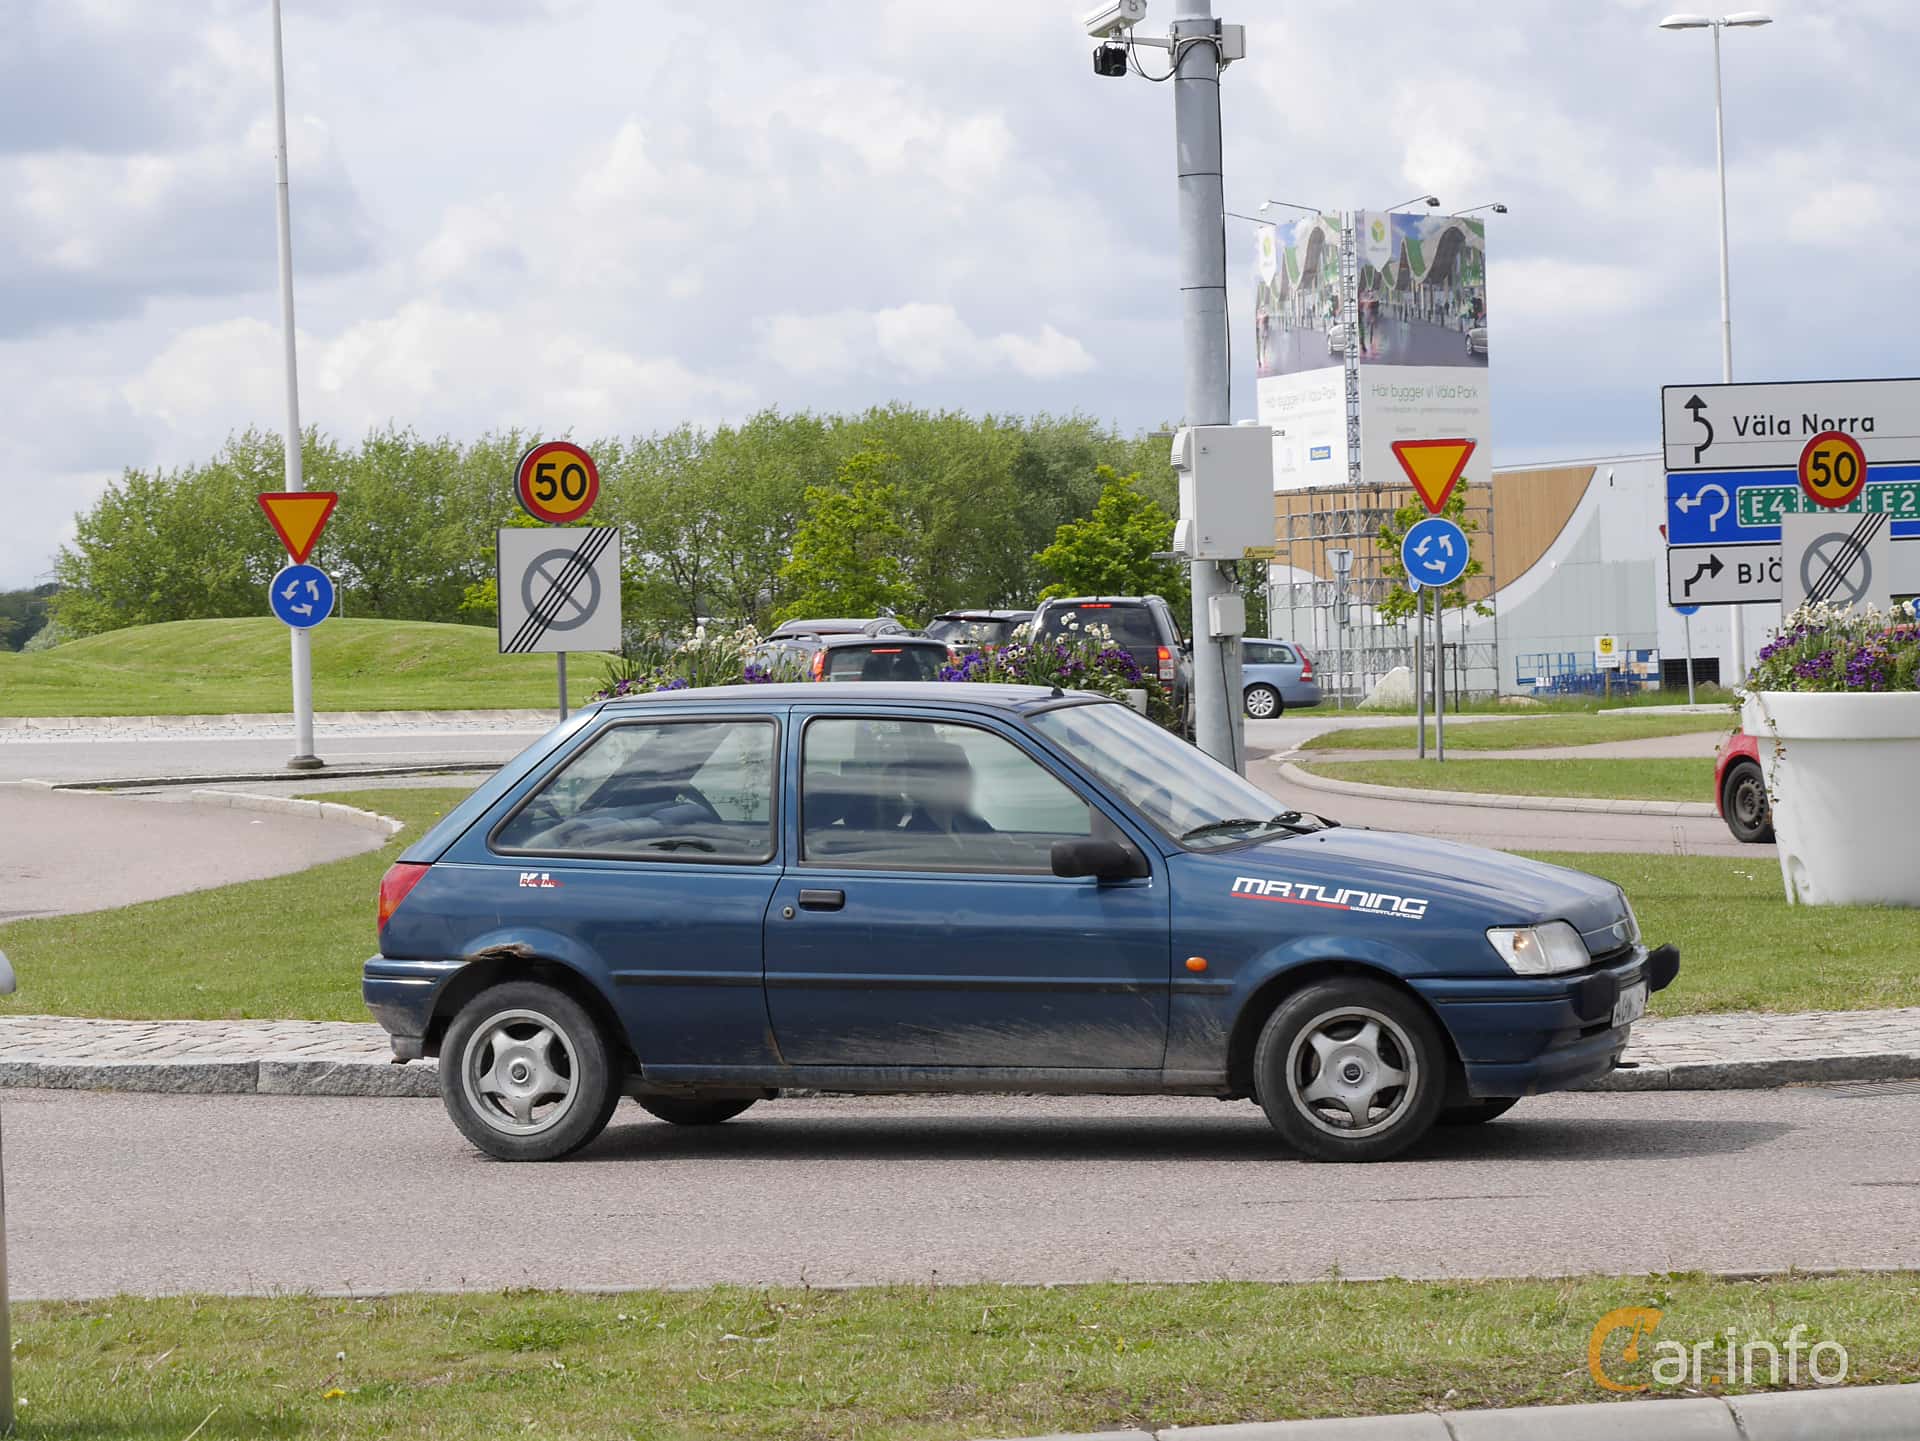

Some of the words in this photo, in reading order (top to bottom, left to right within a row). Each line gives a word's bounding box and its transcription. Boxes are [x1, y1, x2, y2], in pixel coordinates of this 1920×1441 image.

[1733, 415, 1790, 437] Väla
[1802, 413, 1875, 433] Norra
[535, 462, 587, 502] 50
[1811, 451, 1857, 488] 50
[1751, 495, 1786, 517] E4
